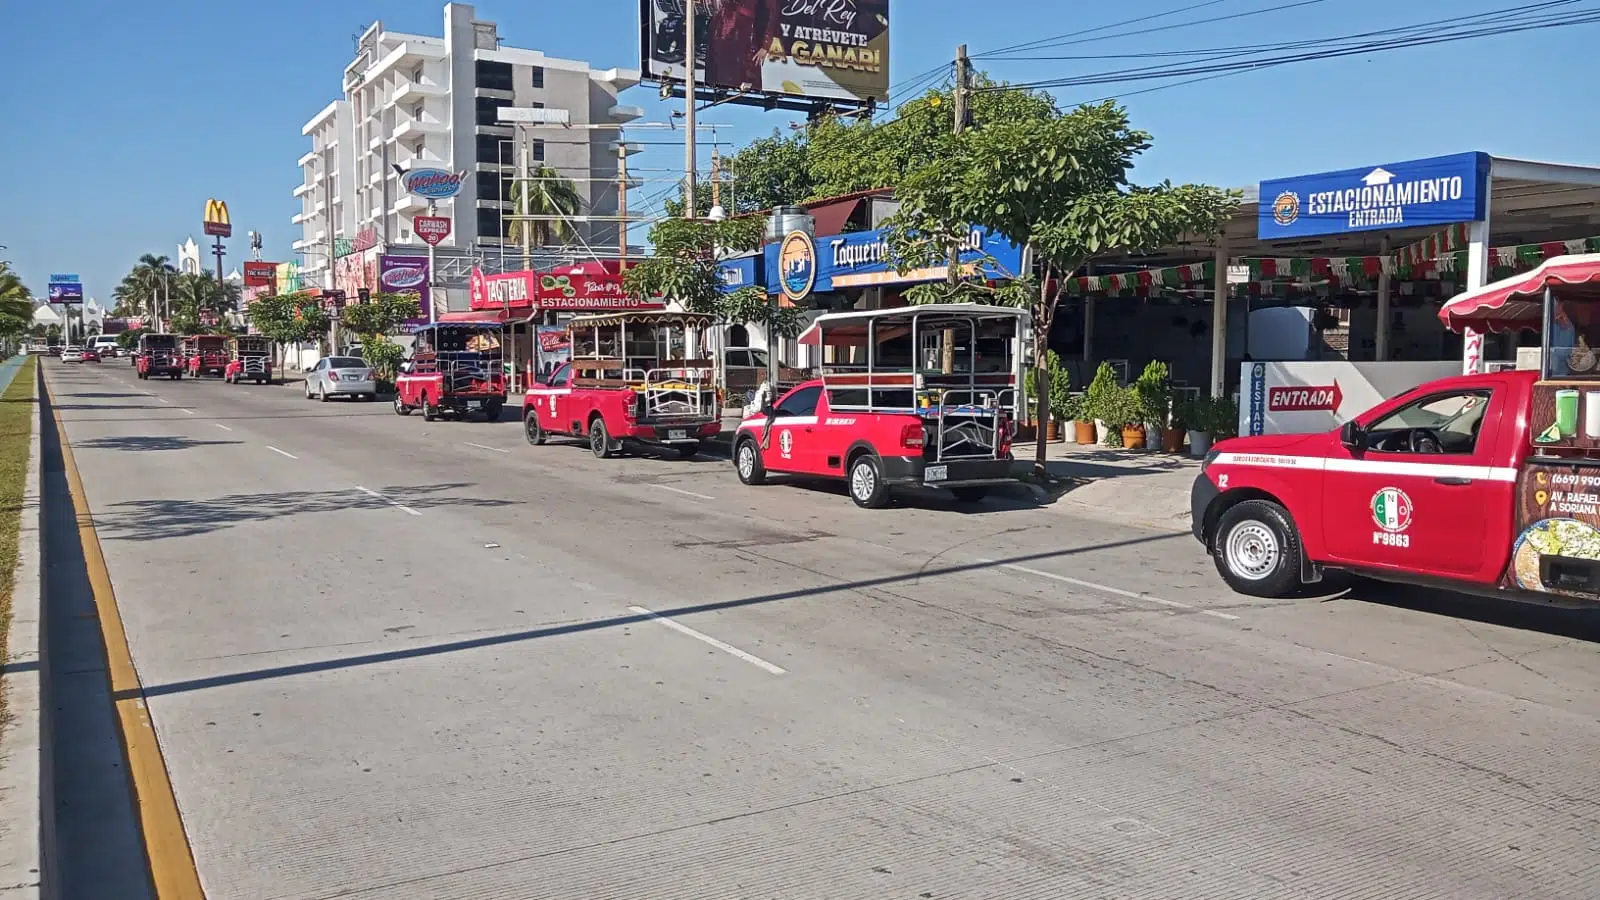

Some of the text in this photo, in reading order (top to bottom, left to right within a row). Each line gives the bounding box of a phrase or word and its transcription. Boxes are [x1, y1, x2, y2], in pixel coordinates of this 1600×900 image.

[820, 0, 856, 30] Rey
[780, 23, 868, 47] Y ATRÉVETE
[769, 36, 880, 72] A GANAR!
[1308, 176, 1462, 215] ESTACIONAMIENTO
[1348, 207, 1404, 228] ENTRADA
[486, 278, 529, 303] TAQERIA
[541, 297, 639, 308] ESTACIONAMIENTO
[1271, 390, 1335, 406] ENTRADA
[1218, 474, 1229, 488] 12
[1552, 473, 1600, 486] (669) 990
[1551, 491, 1600, 505] AV. RAFAEL
[1549, 501, 1597, 515] A SORIANA
